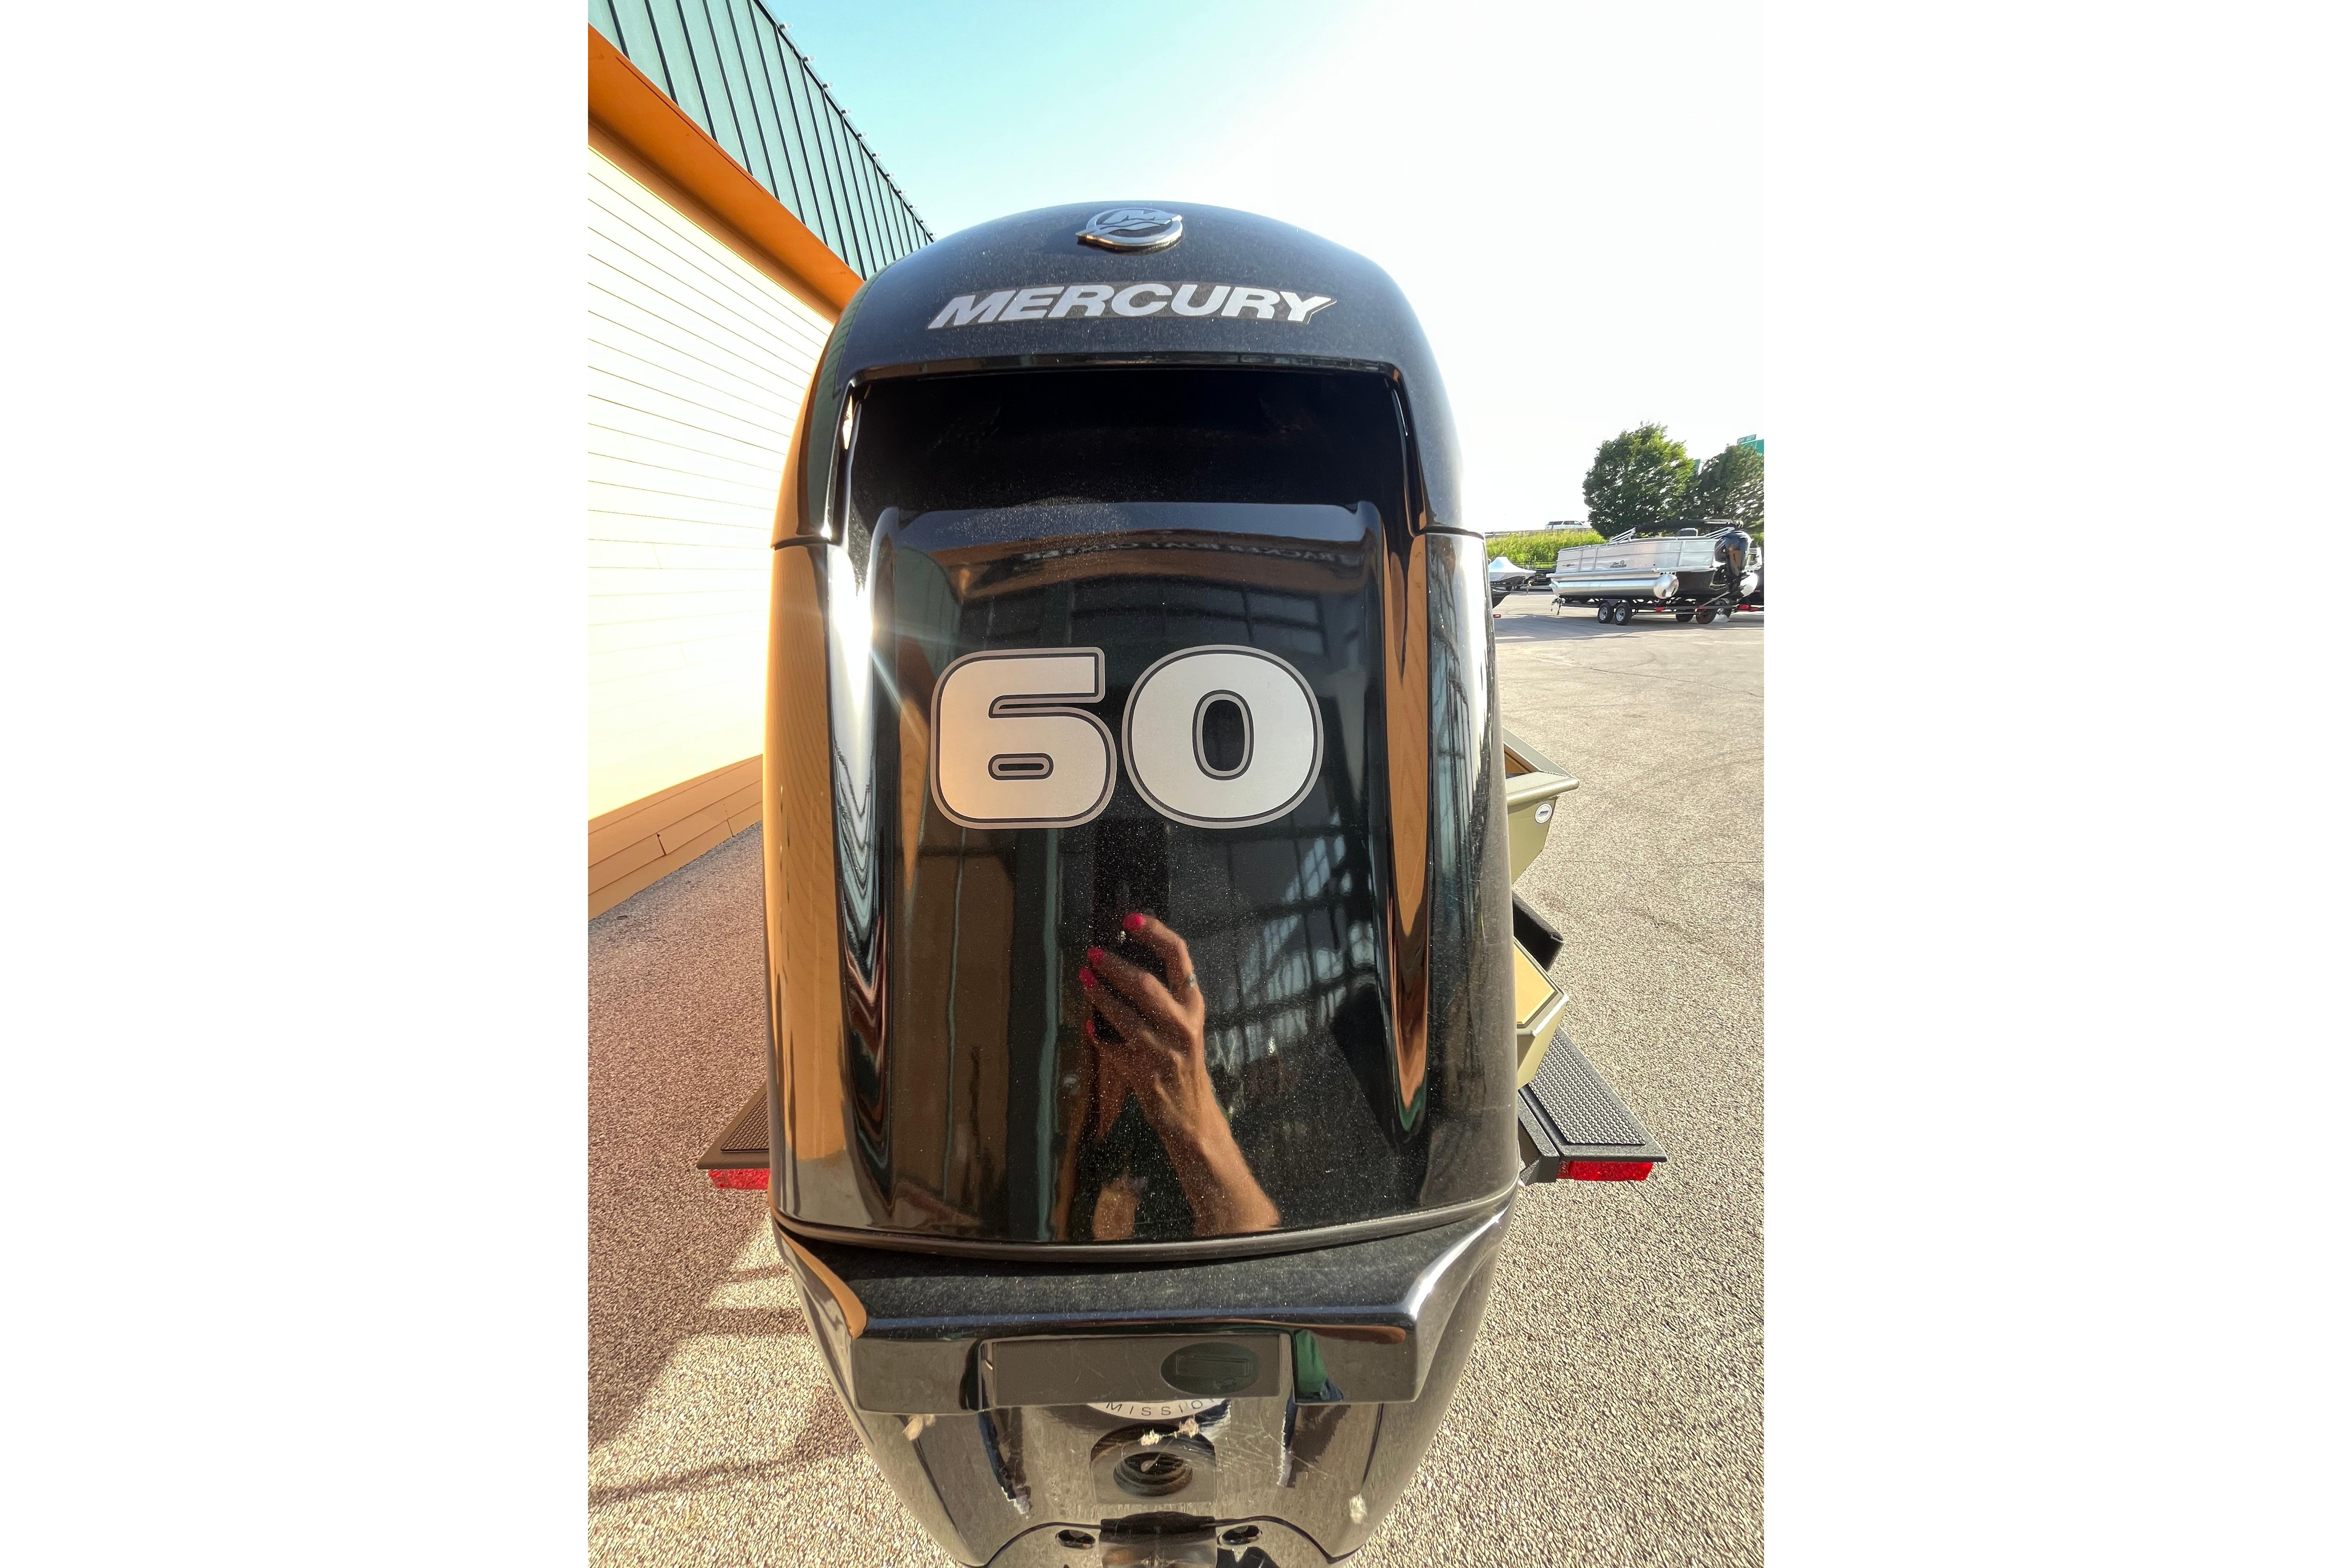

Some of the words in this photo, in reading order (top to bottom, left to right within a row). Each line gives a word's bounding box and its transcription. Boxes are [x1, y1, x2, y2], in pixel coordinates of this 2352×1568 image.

[927, 283, 1334, 330] MERCURY
[931, 644, 1323, 830] 60
[1106, 1399, 1214, 1416] MISSIO
